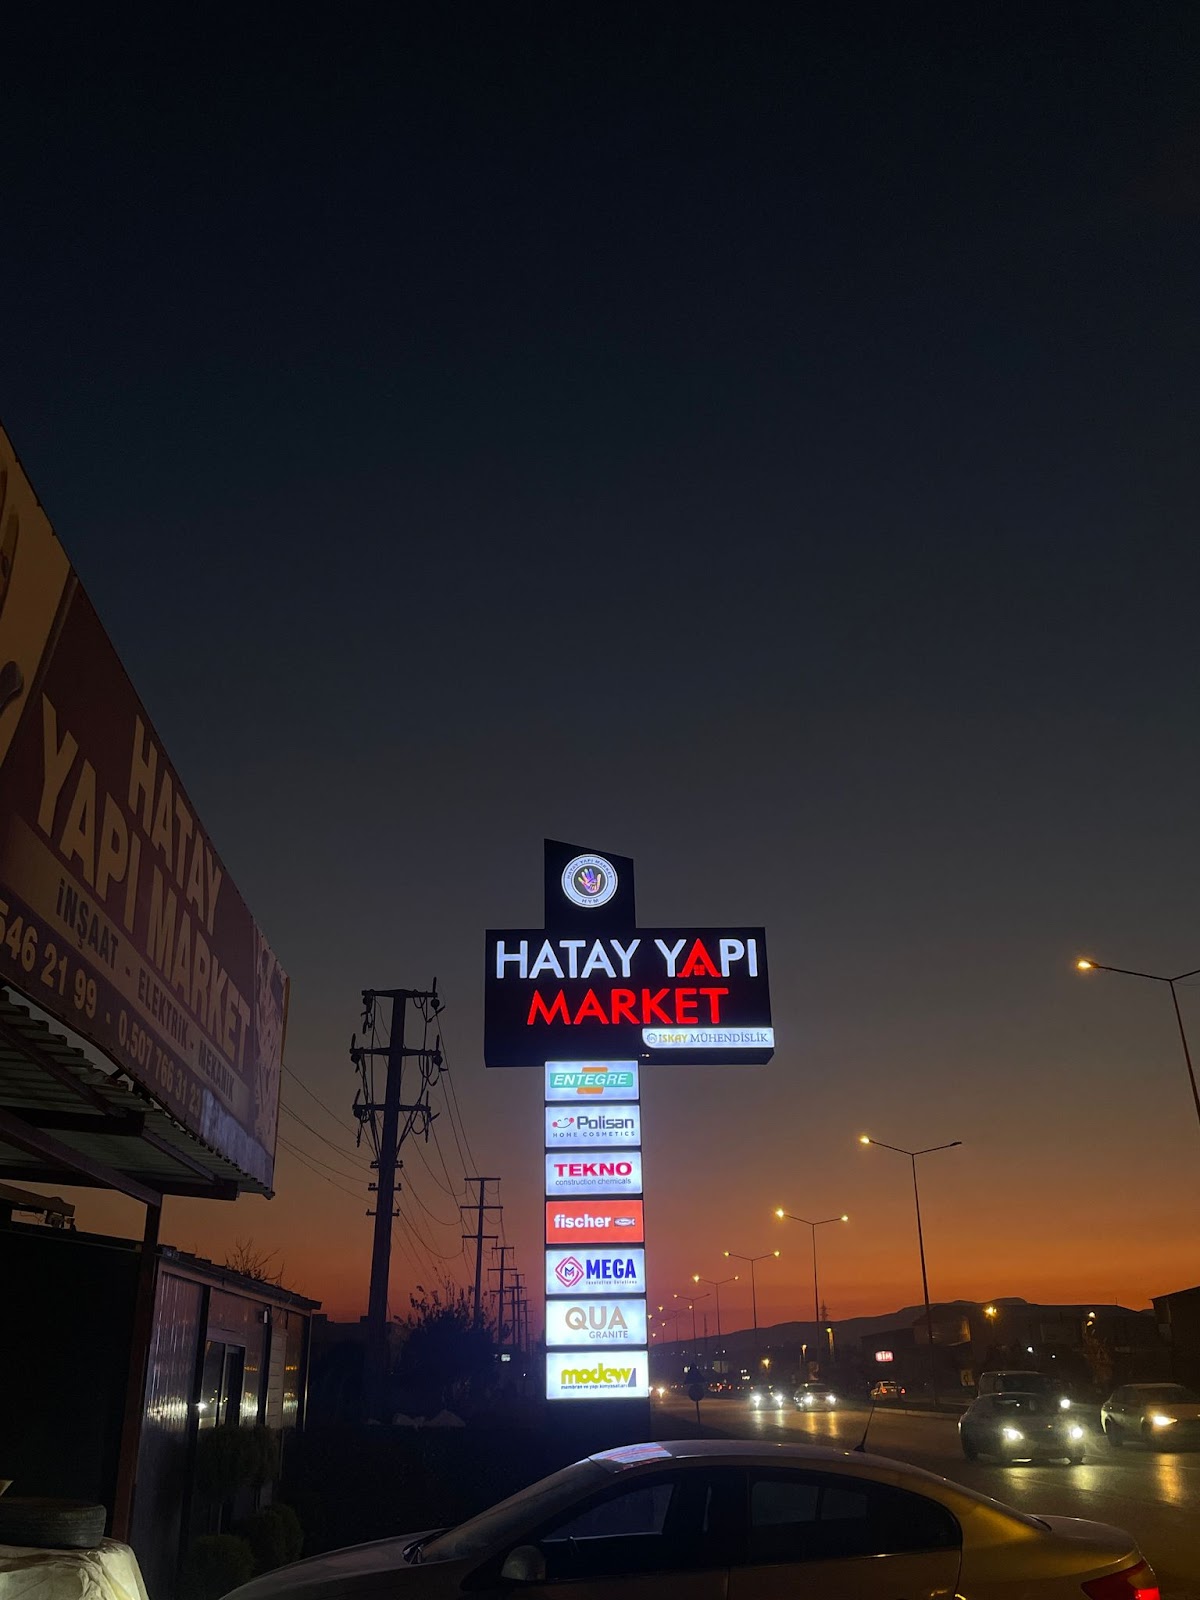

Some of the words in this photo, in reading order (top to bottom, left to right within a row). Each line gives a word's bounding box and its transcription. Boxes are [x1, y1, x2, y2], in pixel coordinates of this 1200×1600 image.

[128, 714, 222, 936] HATAY
[37, 691, 141, 934] YAPI
[146, 863, 251, 1073] MARKET
[496, 938, 641, 979] HATAY
[654, 937, 758, 979] YAPI
[137, 967, 190, 1050] ELEKTRİK
[526, 987, 729, 1026] MARKET
[40, 942, 68, 996] 21
[73, 968, 97, 1020] 99
[155, 1046, 175, 1093] 766
[175, 1069, 188, 1106] 31
[690, 1031, 769, 1043] MÜHENDİSLİK
[553, 1073, 629, 1086] ENTEGRE
[577, 1115, 634, 1130] Polisan
[553, 1162, 633, 1177] TEKNO
[555, 1178, 596, 1186] construction
[597, 1177, 632, 1186] chemicals
[554, 1213, 611, 1229] fischer
[586, 1258, 637, 1280] MEGA
[565, 1305, 628, 1331] QUA
[589, 1330, 629, 1339] GRANITE
